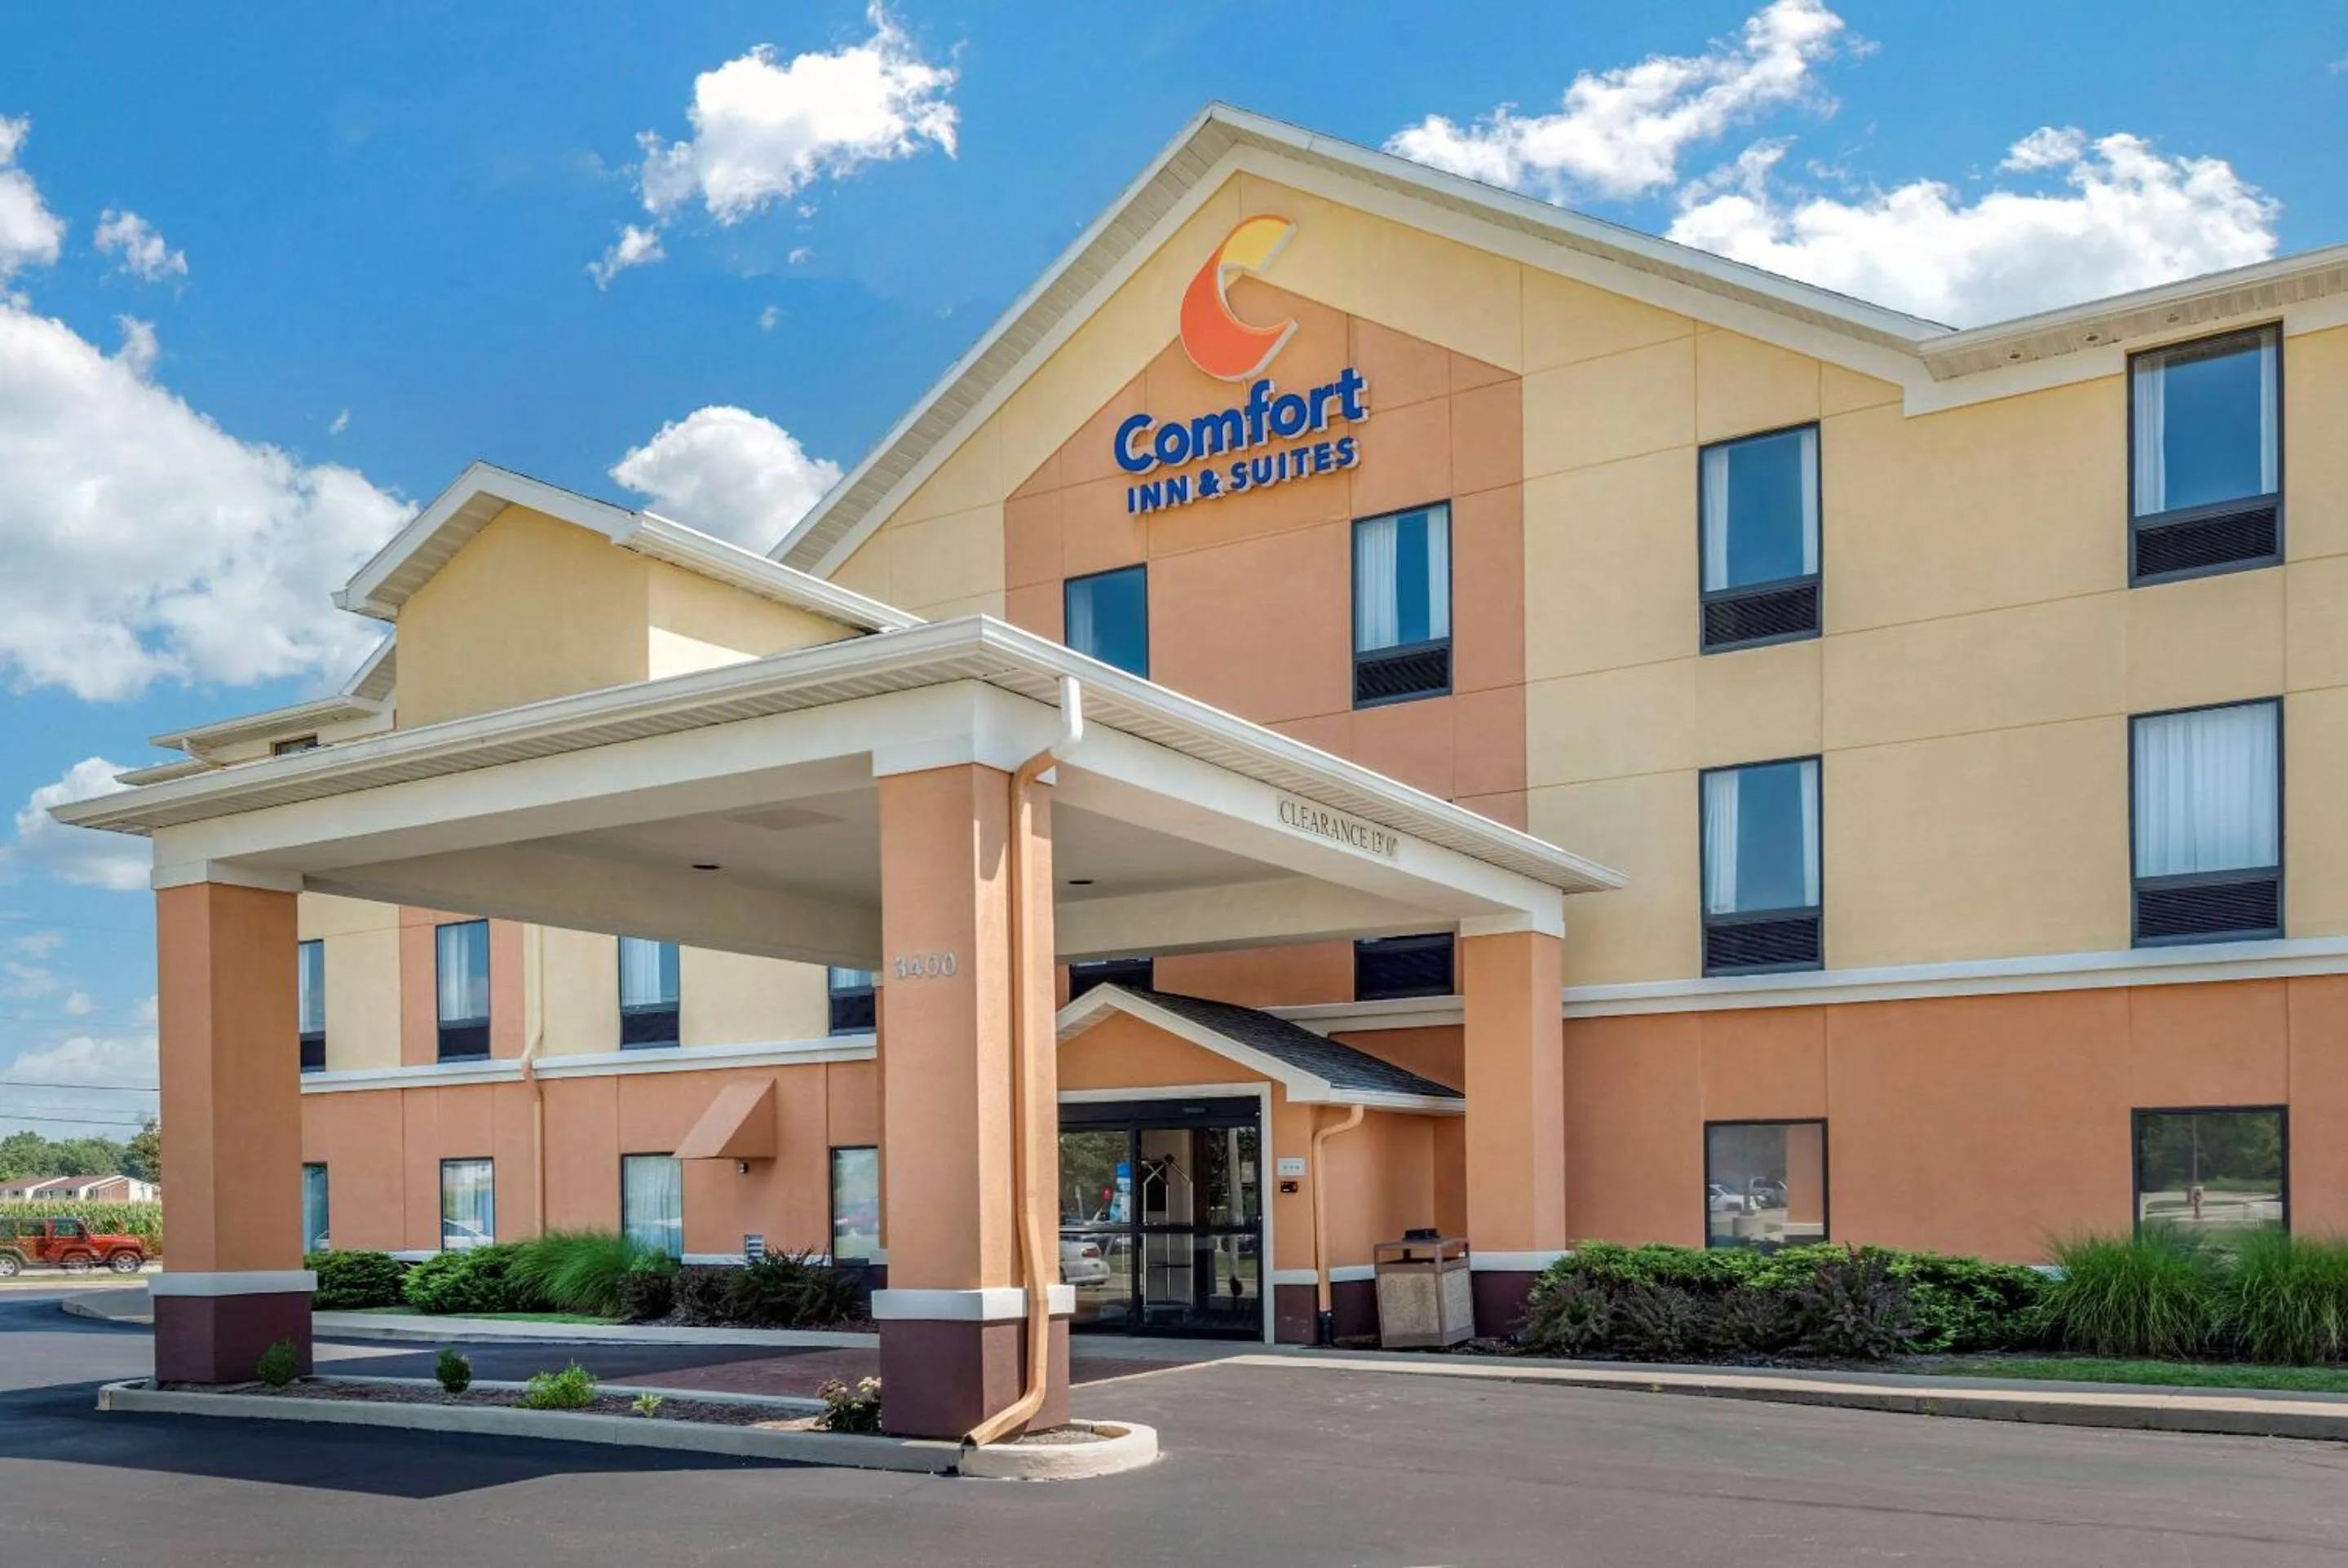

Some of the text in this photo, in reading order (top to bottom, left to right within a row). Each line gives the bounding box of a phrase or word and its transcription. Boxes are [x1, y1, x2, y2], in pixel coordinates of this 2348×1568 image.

[1113, 367, 1366, 472] Comfort
[1127, 437, 1358, 514] INN & SUITES
[1280, 800, 1368, 849] CLEARANCE
[895, 952, 957, 978] 3400
